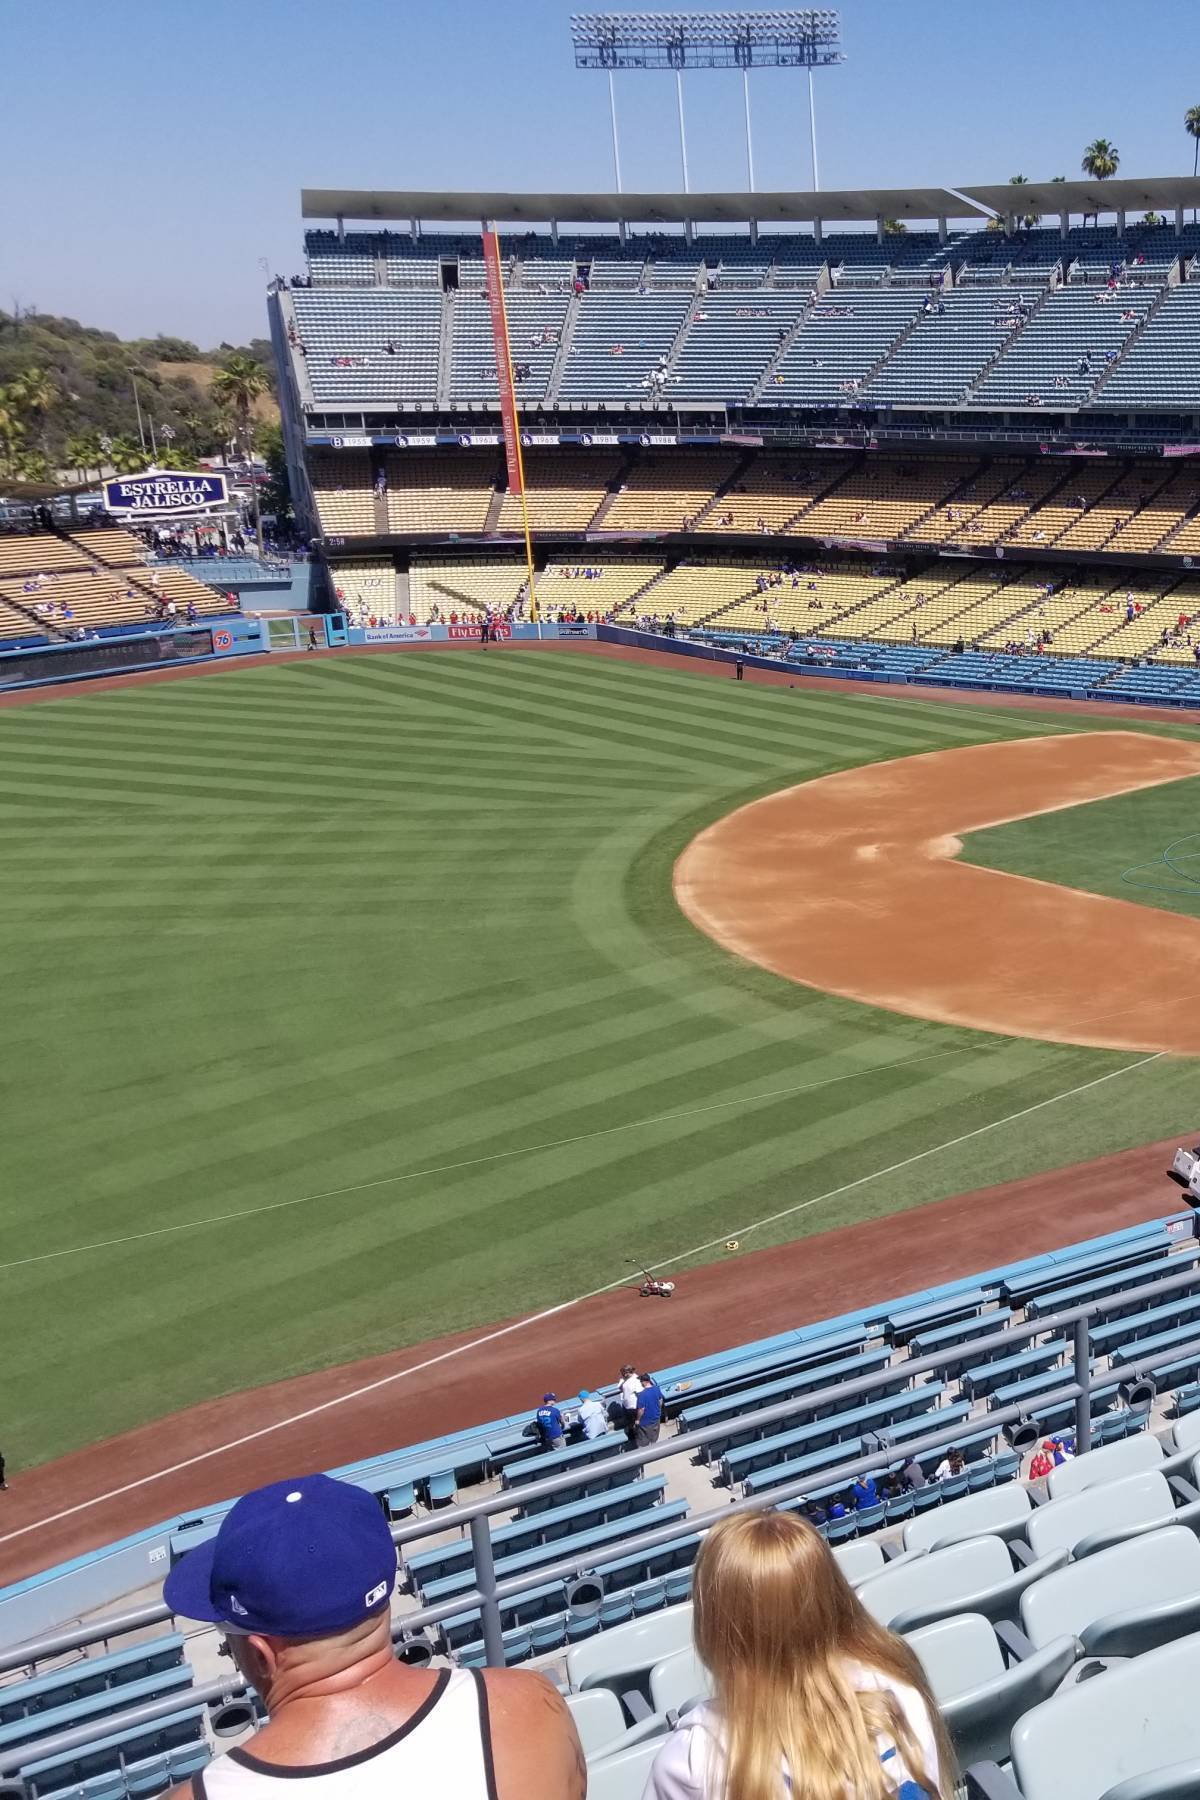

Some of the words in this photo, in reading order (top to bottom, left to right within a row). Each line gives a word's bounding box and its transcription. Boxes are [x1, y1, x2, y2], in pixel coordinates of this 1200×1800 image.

[397, 402, 489, 411] DODGER
[624, 402, 674, 411] CLUB
[504, 415, 515, 456] Emirates
[536, 436, 555, 444] 1965
[596, 436, 614, 444] 1981
[655, 436, 673, 444] 1988
[412, 437, 431, 445] 1959
[507, 457, 517, 474] Fly
[120, 480, 213, 497] ESTRELLA
[131, 493, 205, 508] JALISCO
[451, 628, 467, 637] Fly
[216, 633, 231, 647] 76
